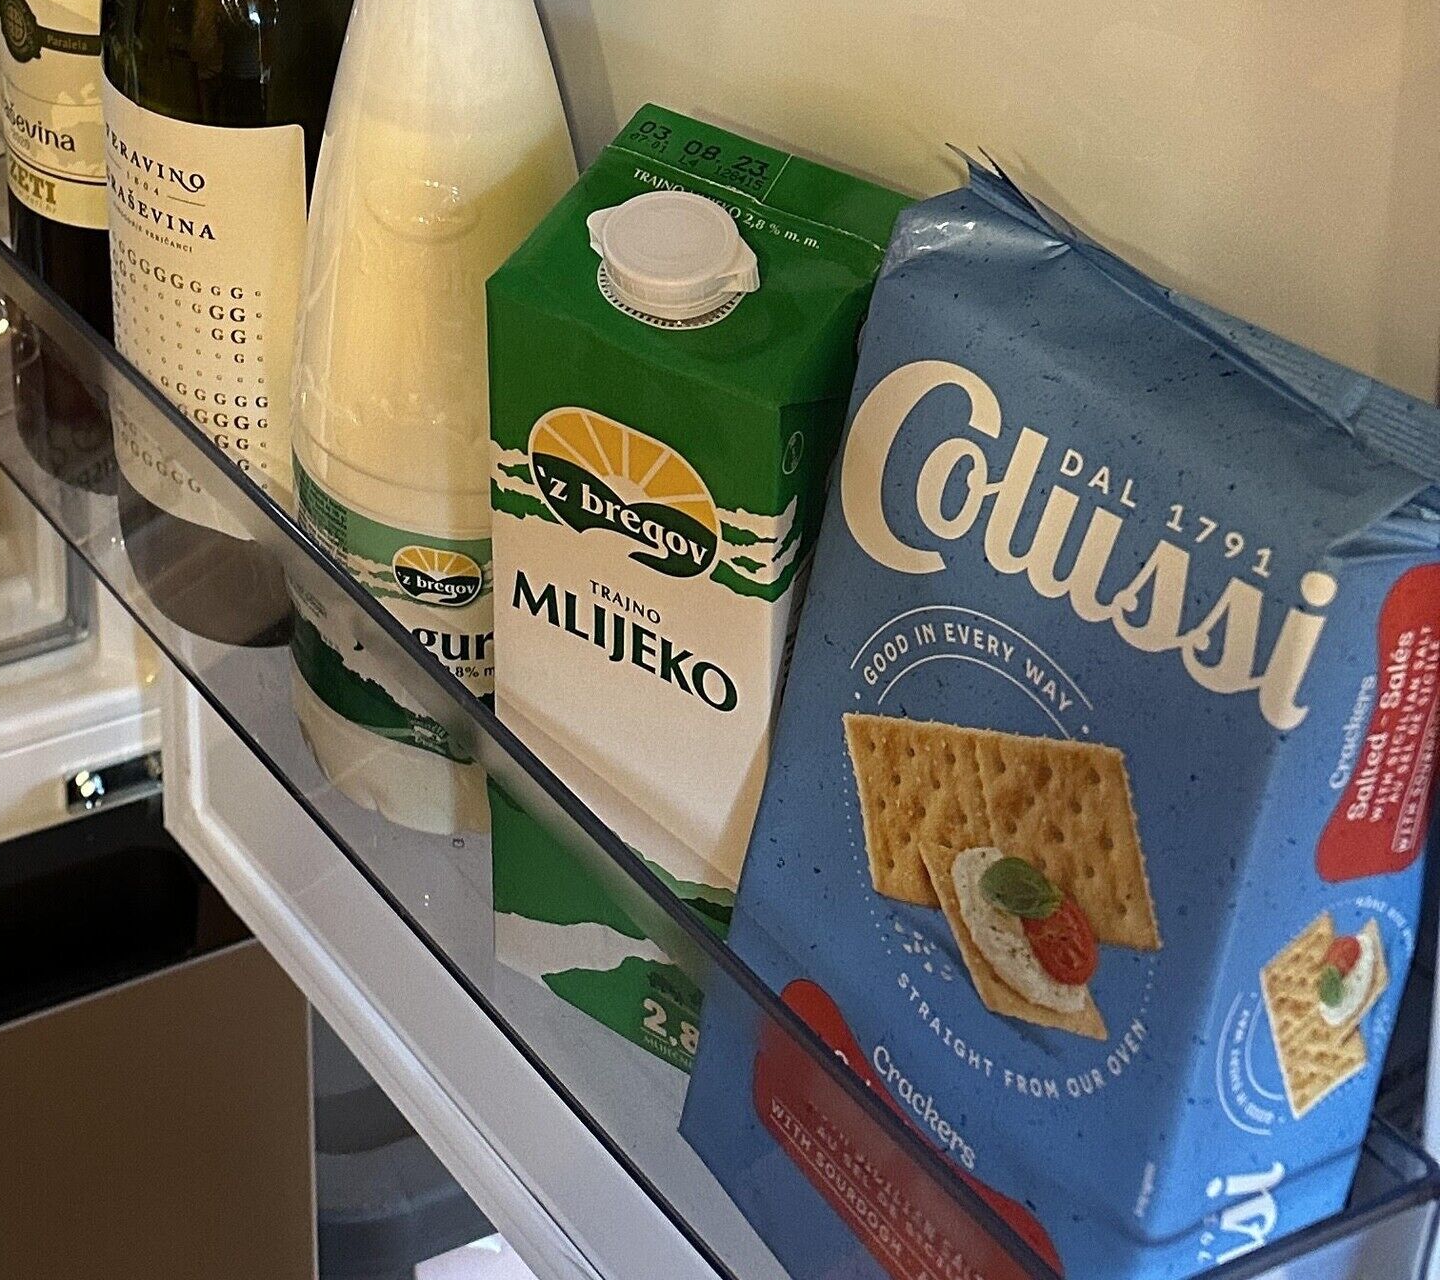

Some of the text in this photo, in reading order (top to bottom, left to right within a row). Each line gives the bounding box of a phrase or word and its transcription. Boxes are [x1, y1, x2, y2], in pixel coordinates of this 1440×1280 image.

[106, 164, 217, 241] RAŠEVINA
[742, 212, 821, 249] 2,8 % m. m.
[580, 485, 709, 570] bregov
[840, 359, 1341, 732] Colussi
[1061, 447, 1276, 579] DAL 1791
[415, 575, 477, 596] bregov
[589, 577, 662, 625] TRAJNO
[511, 567, 739, 713] MLIJEKO
[863, 622, 1074, 713] GOOD IN EVERY WAY
[1328, 675, 1378, 790] Crackers
[1347, 630, 1416, 822] Salted Salés
[896, 972, 1149, 1100] STRAIGHT FROM OUR OVEN
[770, 1096, 813, 1151] WITH
[872, 1044, 977, 1172] Crackers
